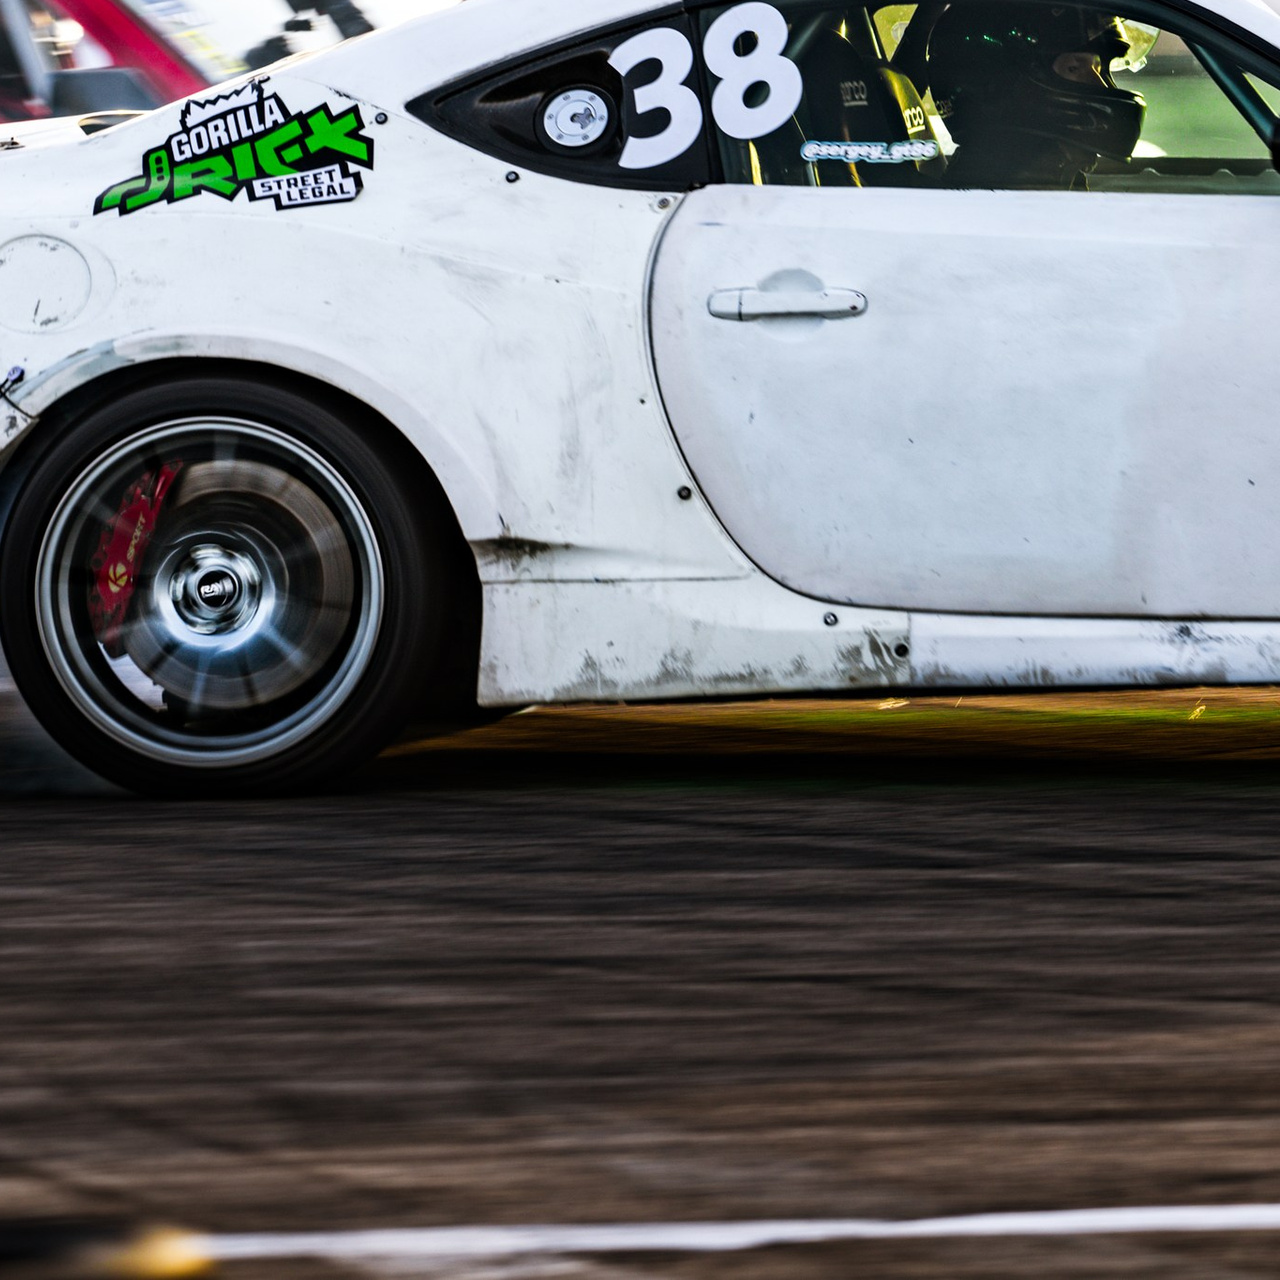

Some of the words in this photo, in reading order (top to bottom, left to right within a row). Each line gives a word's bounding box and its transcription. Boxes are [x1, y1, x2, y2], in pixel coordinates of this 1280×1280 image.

[607, 1, 803, 169] 38
[170, 98, 286, 162] GORILLA
[261, 168, 336, 193] STREET
[286, 184, 350, 202] LEGAL
